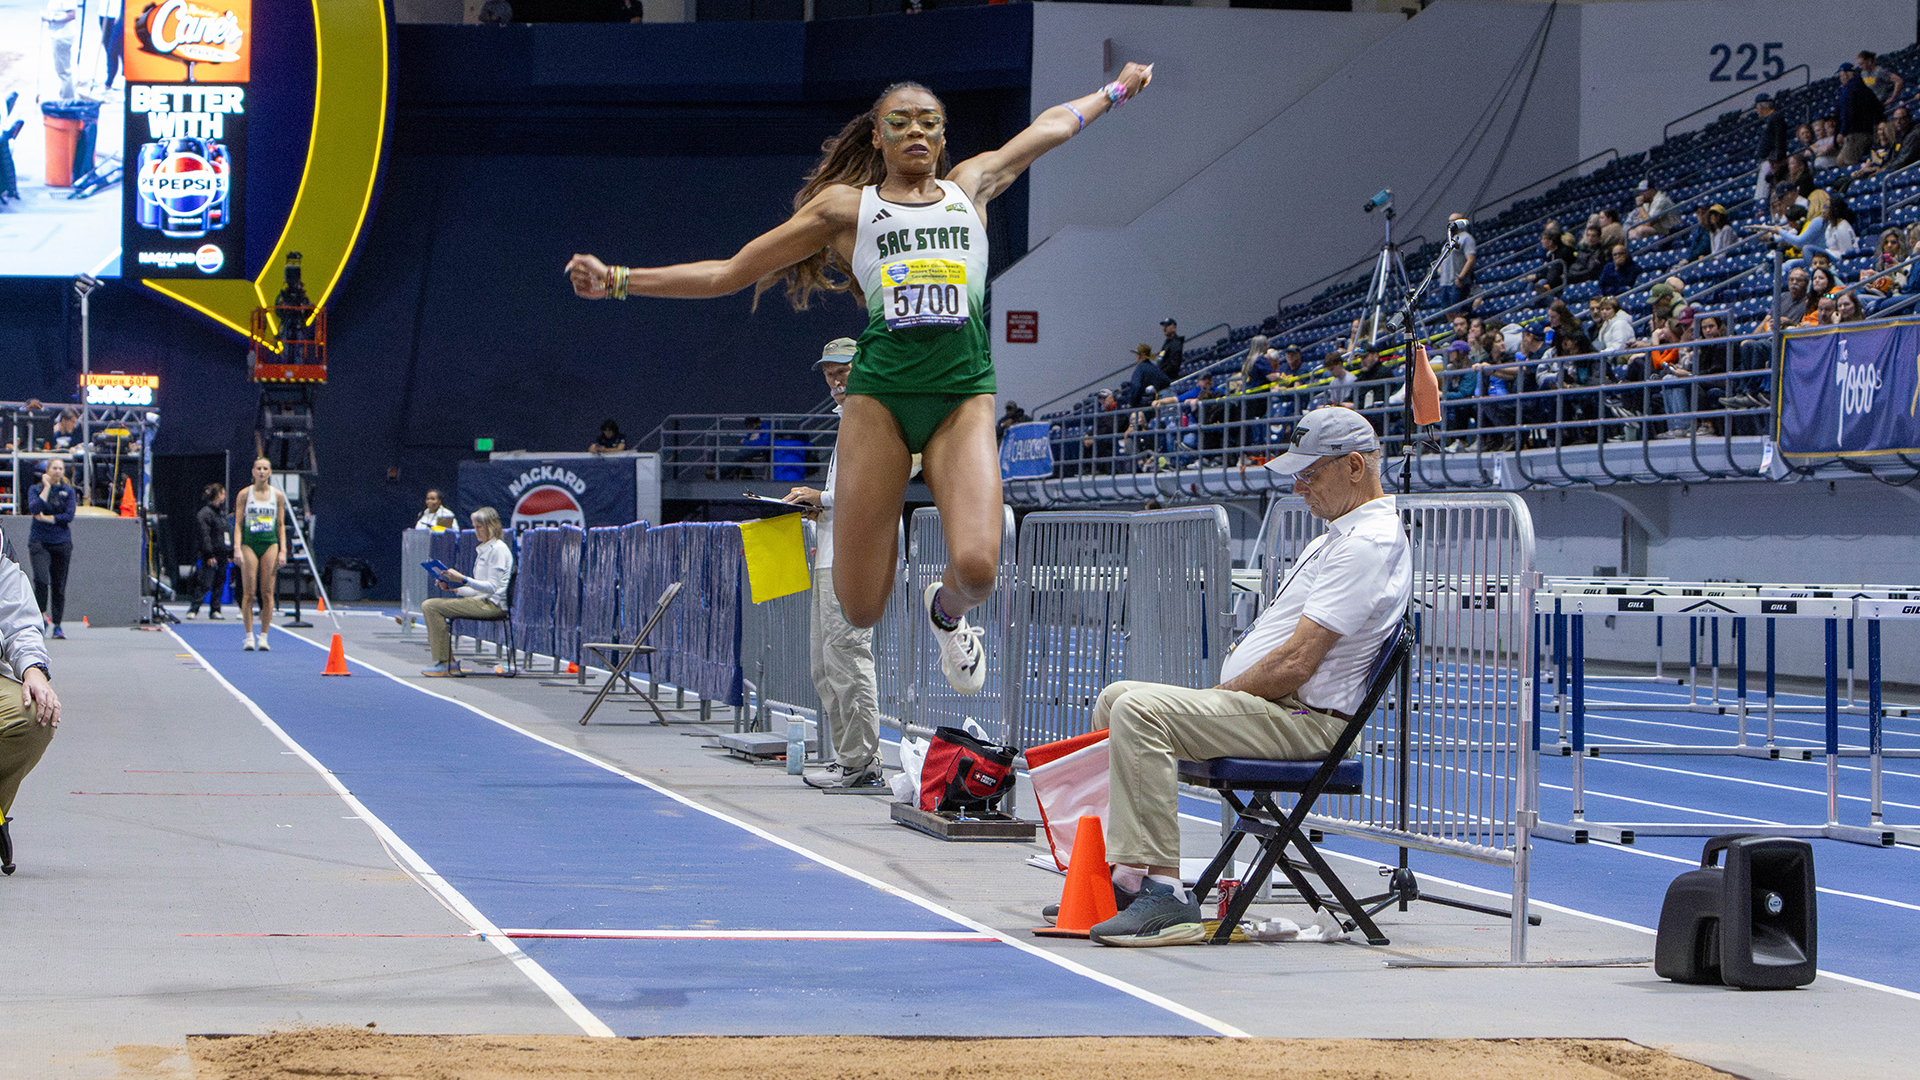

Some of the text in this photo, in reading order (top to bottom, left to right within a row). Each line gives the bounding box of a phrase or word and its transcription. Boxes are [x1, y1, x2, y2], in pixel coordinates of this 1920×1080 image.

[151, 0, 243, 53] Cane's
[1709, 42, 1785, 81] 225
[131, 85, 245, 114] BETTER
[148, 112, 224, 139] WITH
[159, 178, 211, 190] PEPSI
[876, 226, 970, 260] SAC STATE
[893, 284, 959, 317] 5700
[89, 376, 125, 385] Women
[508, 465, 587, 497] NACKARD
[1902, 605, 1920, 614] GIL
